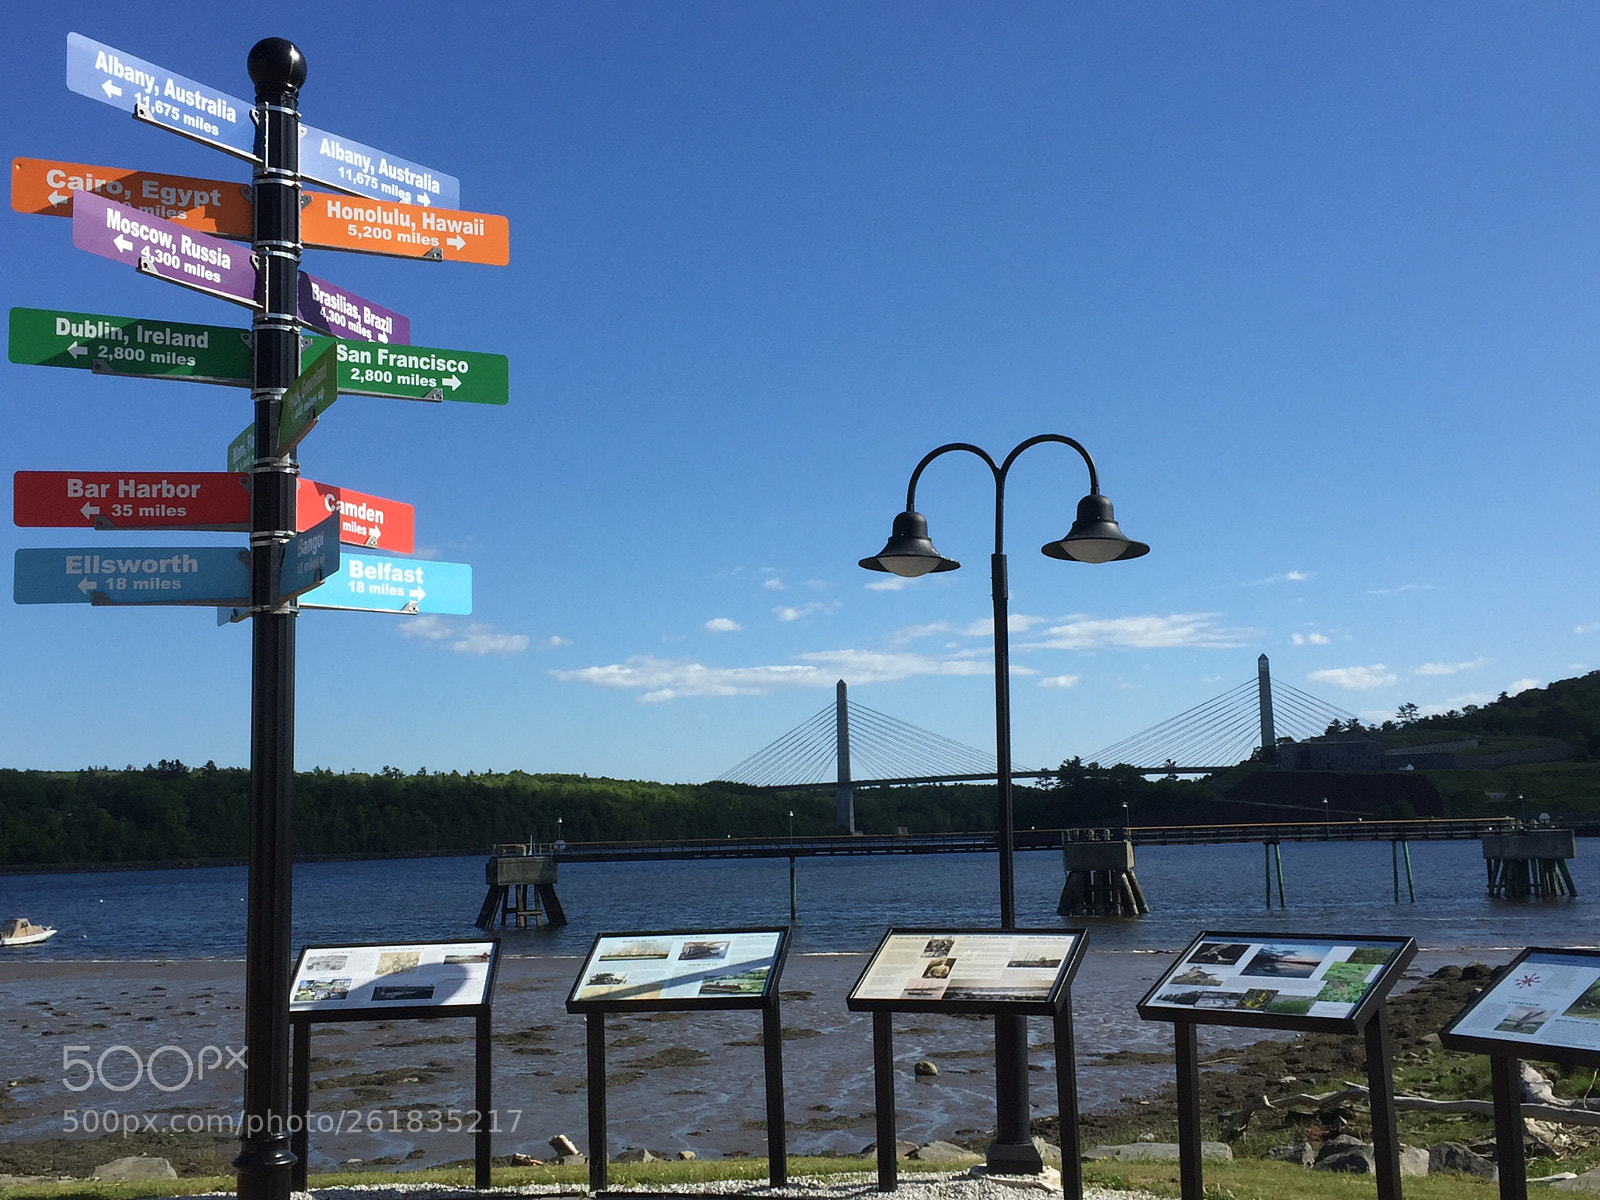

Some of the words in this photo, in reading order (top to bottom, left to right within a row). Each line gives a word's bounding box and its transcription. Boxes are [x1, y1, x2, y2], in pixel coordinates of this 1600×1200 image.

[95, 51, 159, 96] Albany,
[164, 78, 236, 123] Australia
[134, 92, 180, 120] 11,675
[183, 113, 219, 136] miles
[320, 138, 375, 174] Albany,
[379, 157, 440, 194] Australia
[46, 169, 131, 199] Cairo,
[142, 180, 221, 207] Egypt
[338, 166, 378, 189] 11,675
[381, 182, 412, 200] miles
[327, 200, 416, 231] Honolulu,
[422, 212, 484, 236] Hawaii
[106, 207, 177, 255] Moscow,
[181, 234, 231, 270] Russia
[347, 224, 392, 241] 5,200
[397, 232, 440, 247] miles
[140, 245, 181, 270] 4,300
[184, 261, 221, 284] miles
[311, 282, 361, 323] Brasilias,
[364, 306, 393, 335] Brazil
[319, 306, 346, 327] 4,300
[348, 320, 372, 339] miles
[55, 317, 129, 345] Dublin,
[137, 325, 209, 349] Ireland
[98, 345, 145, 361] 2,800
[150, 352, 196, 366] miles
[336, 344, 371, 364] San
[378, 349, 469, 373] Francisco
[350, 368, 392, 384] 2,800
[397, 374, 437, 387] miles
[67, 478, 110, 498] Bar
[118, 479, 201, 499] Harbor
[111, 504, 133, 517] 35
[139, 504, 187, 517] miles
[324, 493, 384, 525] Camden
[342, 521, 367, 536] miles
[65, 554, 198, 575] Ellsworth
[349, 560, 424, 584] Belfast
[106, 577, 127, 590] 18
[133, 577, 182, 590] miles
[348, 581, 365, 593] 18
[369, 583, 405, 597] miles
